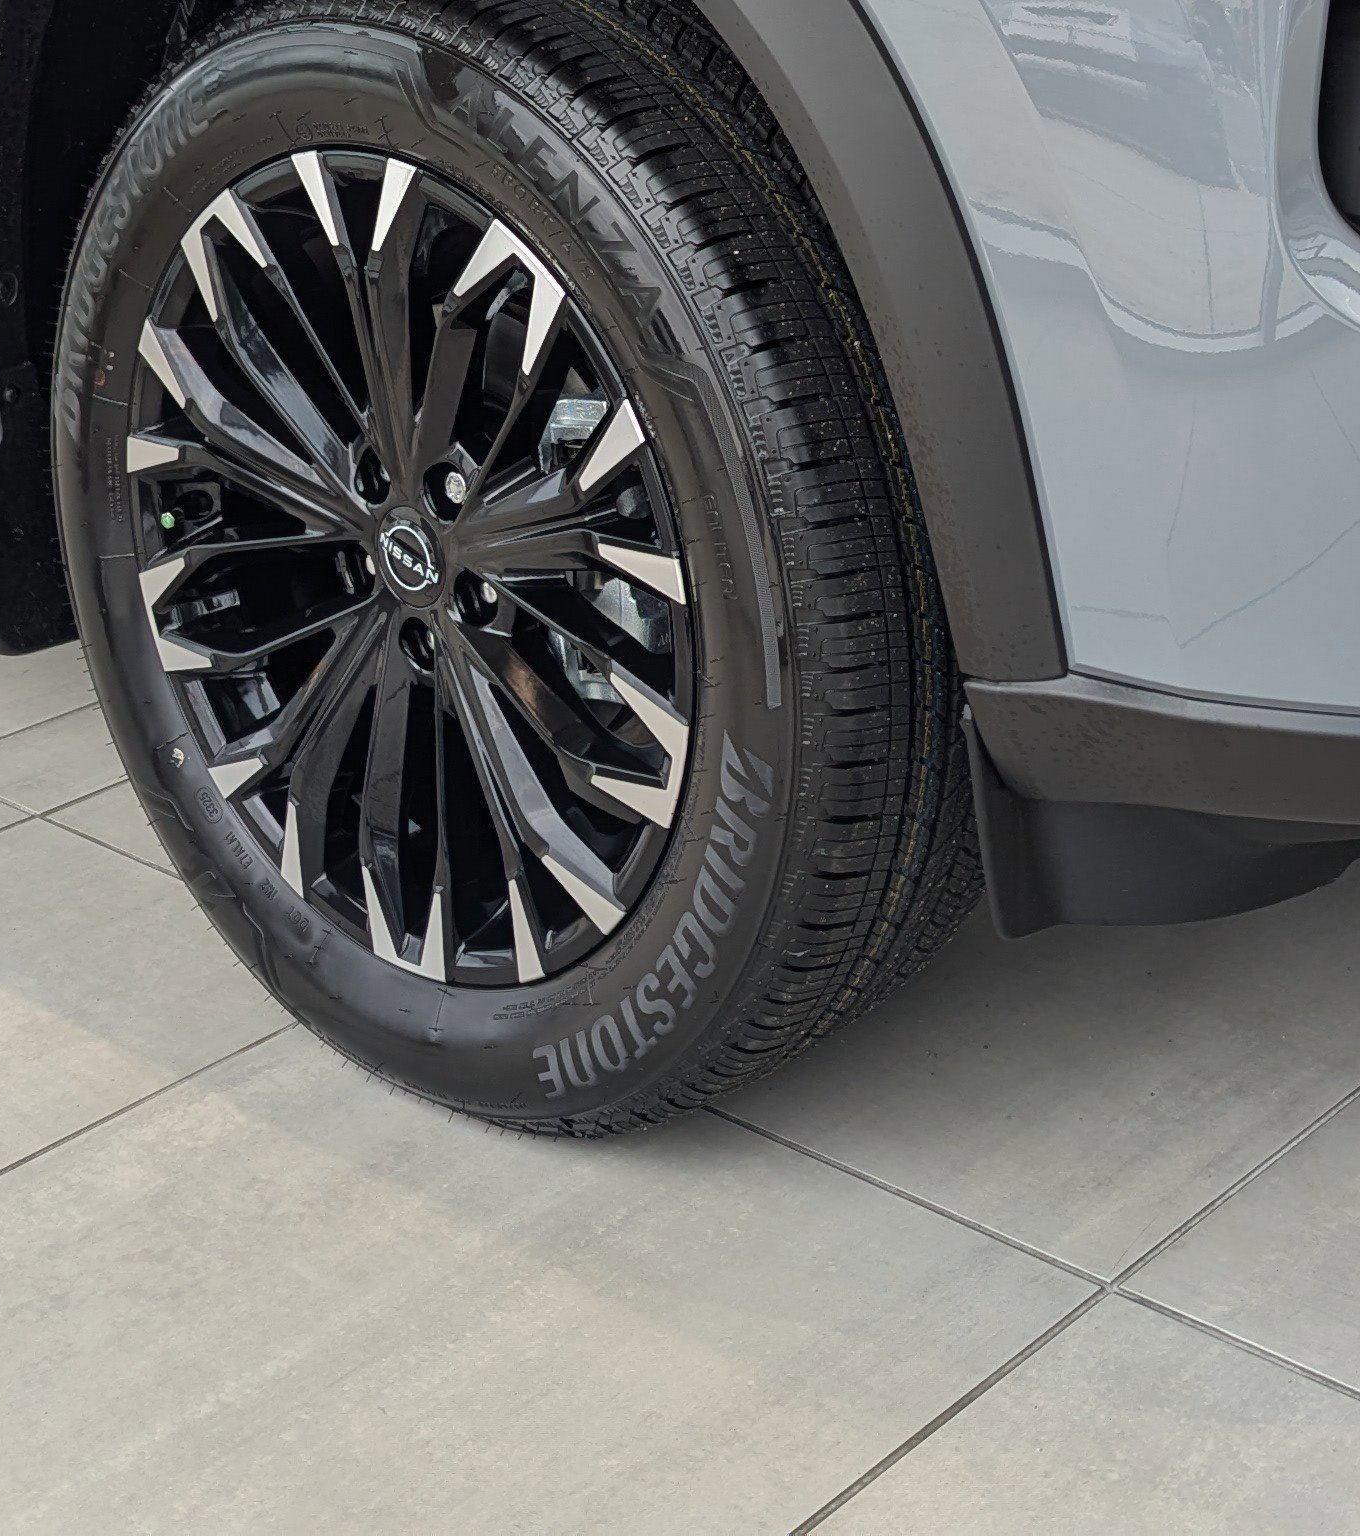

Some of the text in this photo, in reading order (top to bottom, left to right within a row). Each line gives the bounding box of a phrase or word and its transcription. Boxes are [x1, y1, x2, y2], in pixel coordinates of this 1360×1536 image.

[450, 86, 662, 348] ALENZA
[379, 531, 439, 584] NISSAN
[198, 791, 219, 819] 3325
[532, 728, 774, 1099] BRIDGESTONE
